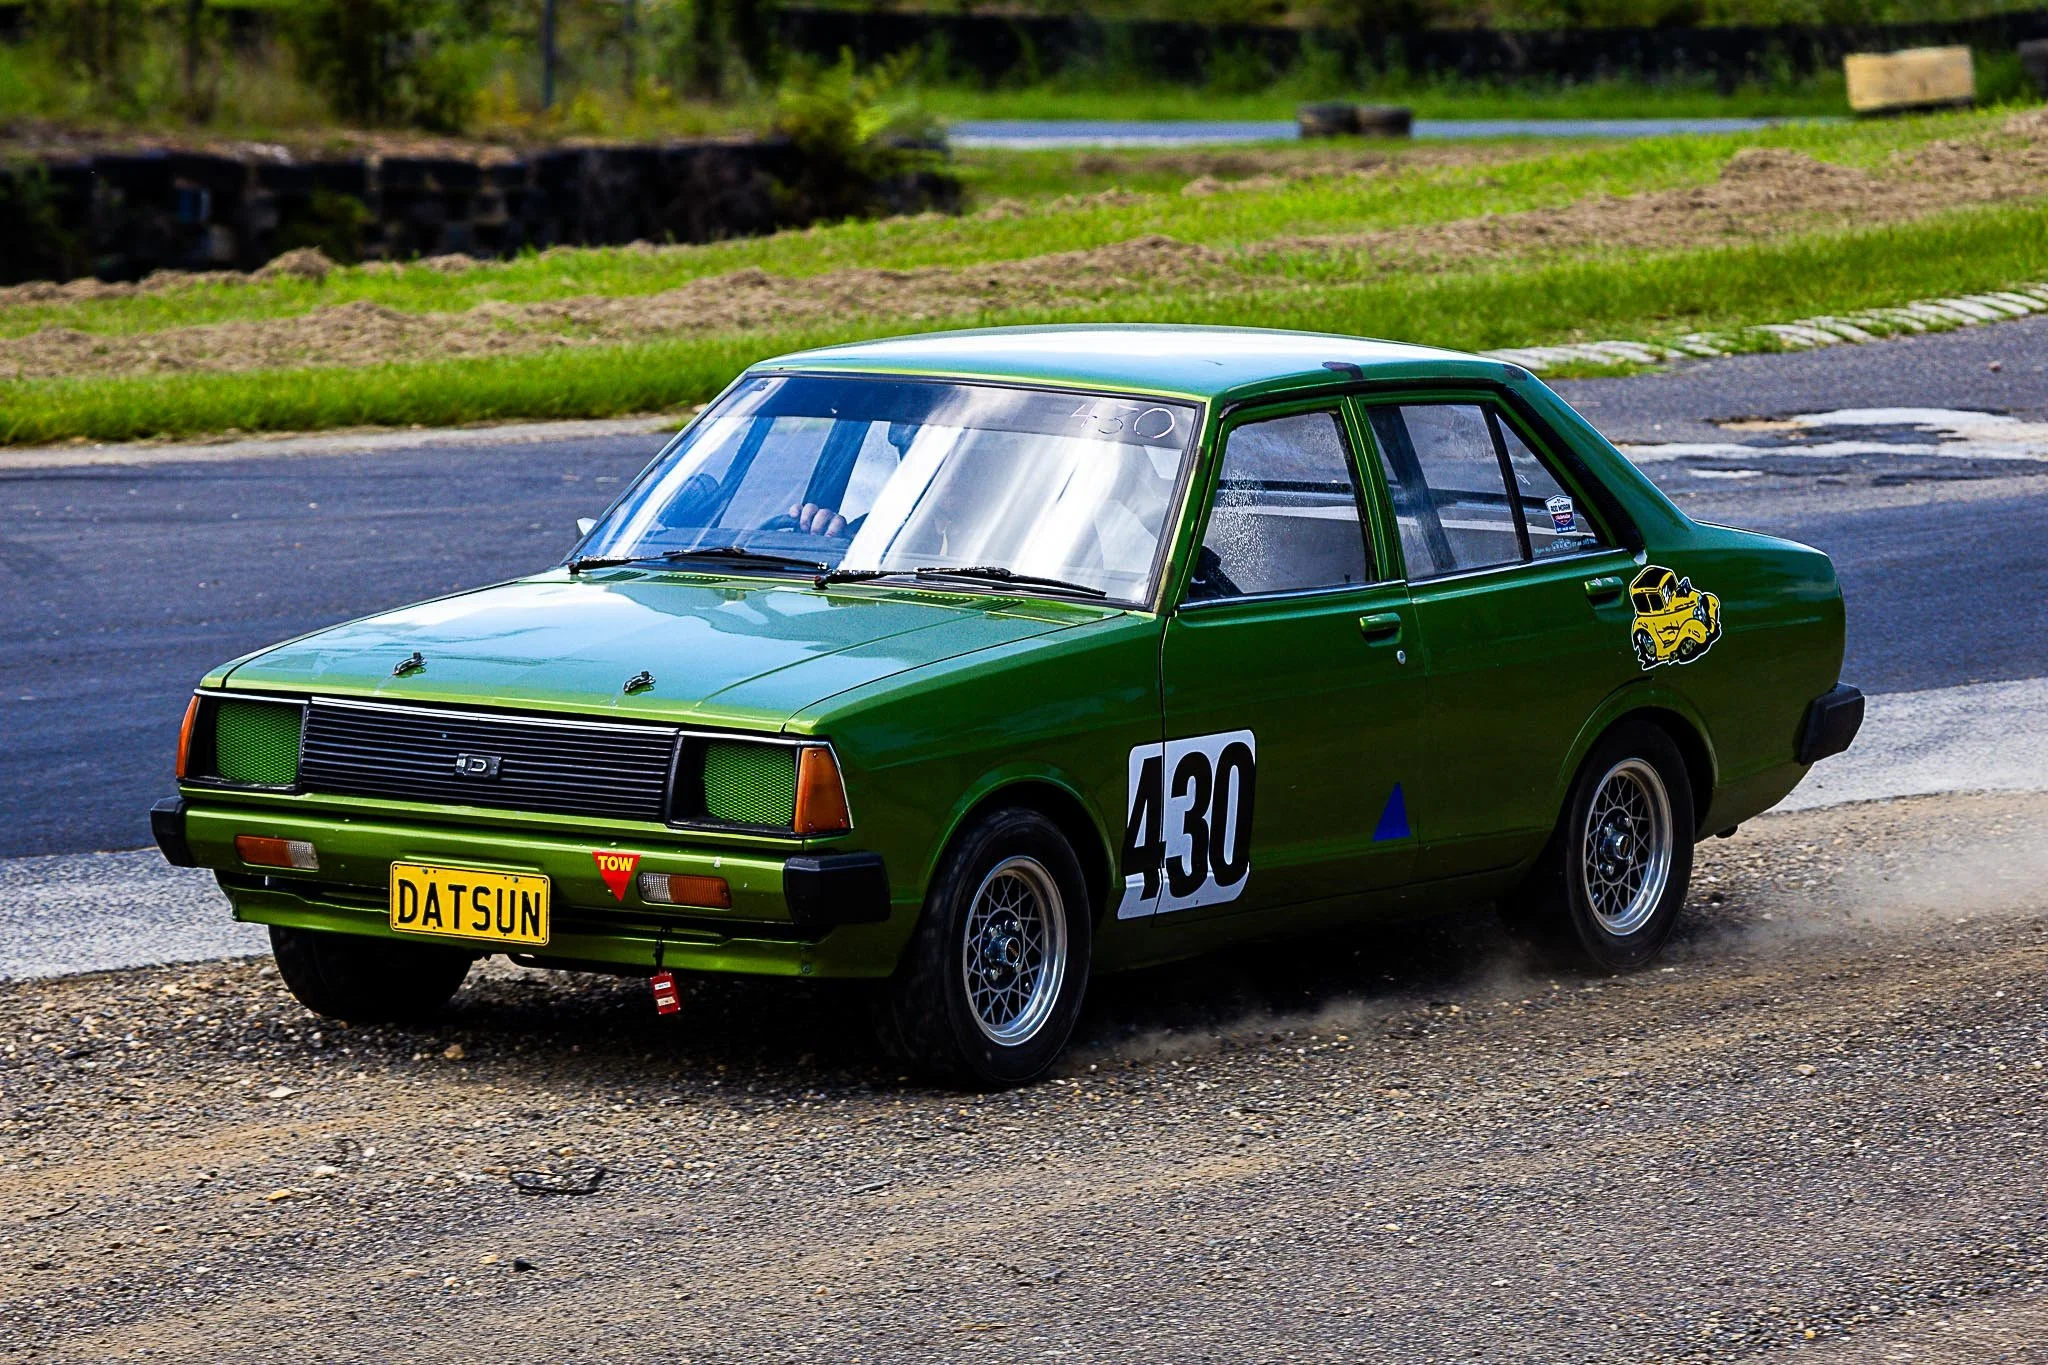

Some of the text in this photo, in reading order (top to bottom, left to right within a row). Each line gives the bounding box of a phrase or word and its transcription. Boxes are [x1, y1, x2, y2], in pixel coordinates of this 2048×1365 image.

[1070, 402, 1175, 439] 430
[1121, 742, 1256, 901] 430
[598, 855, 634, 872] TOW
[398, 878, 541, 937] DATSUN
